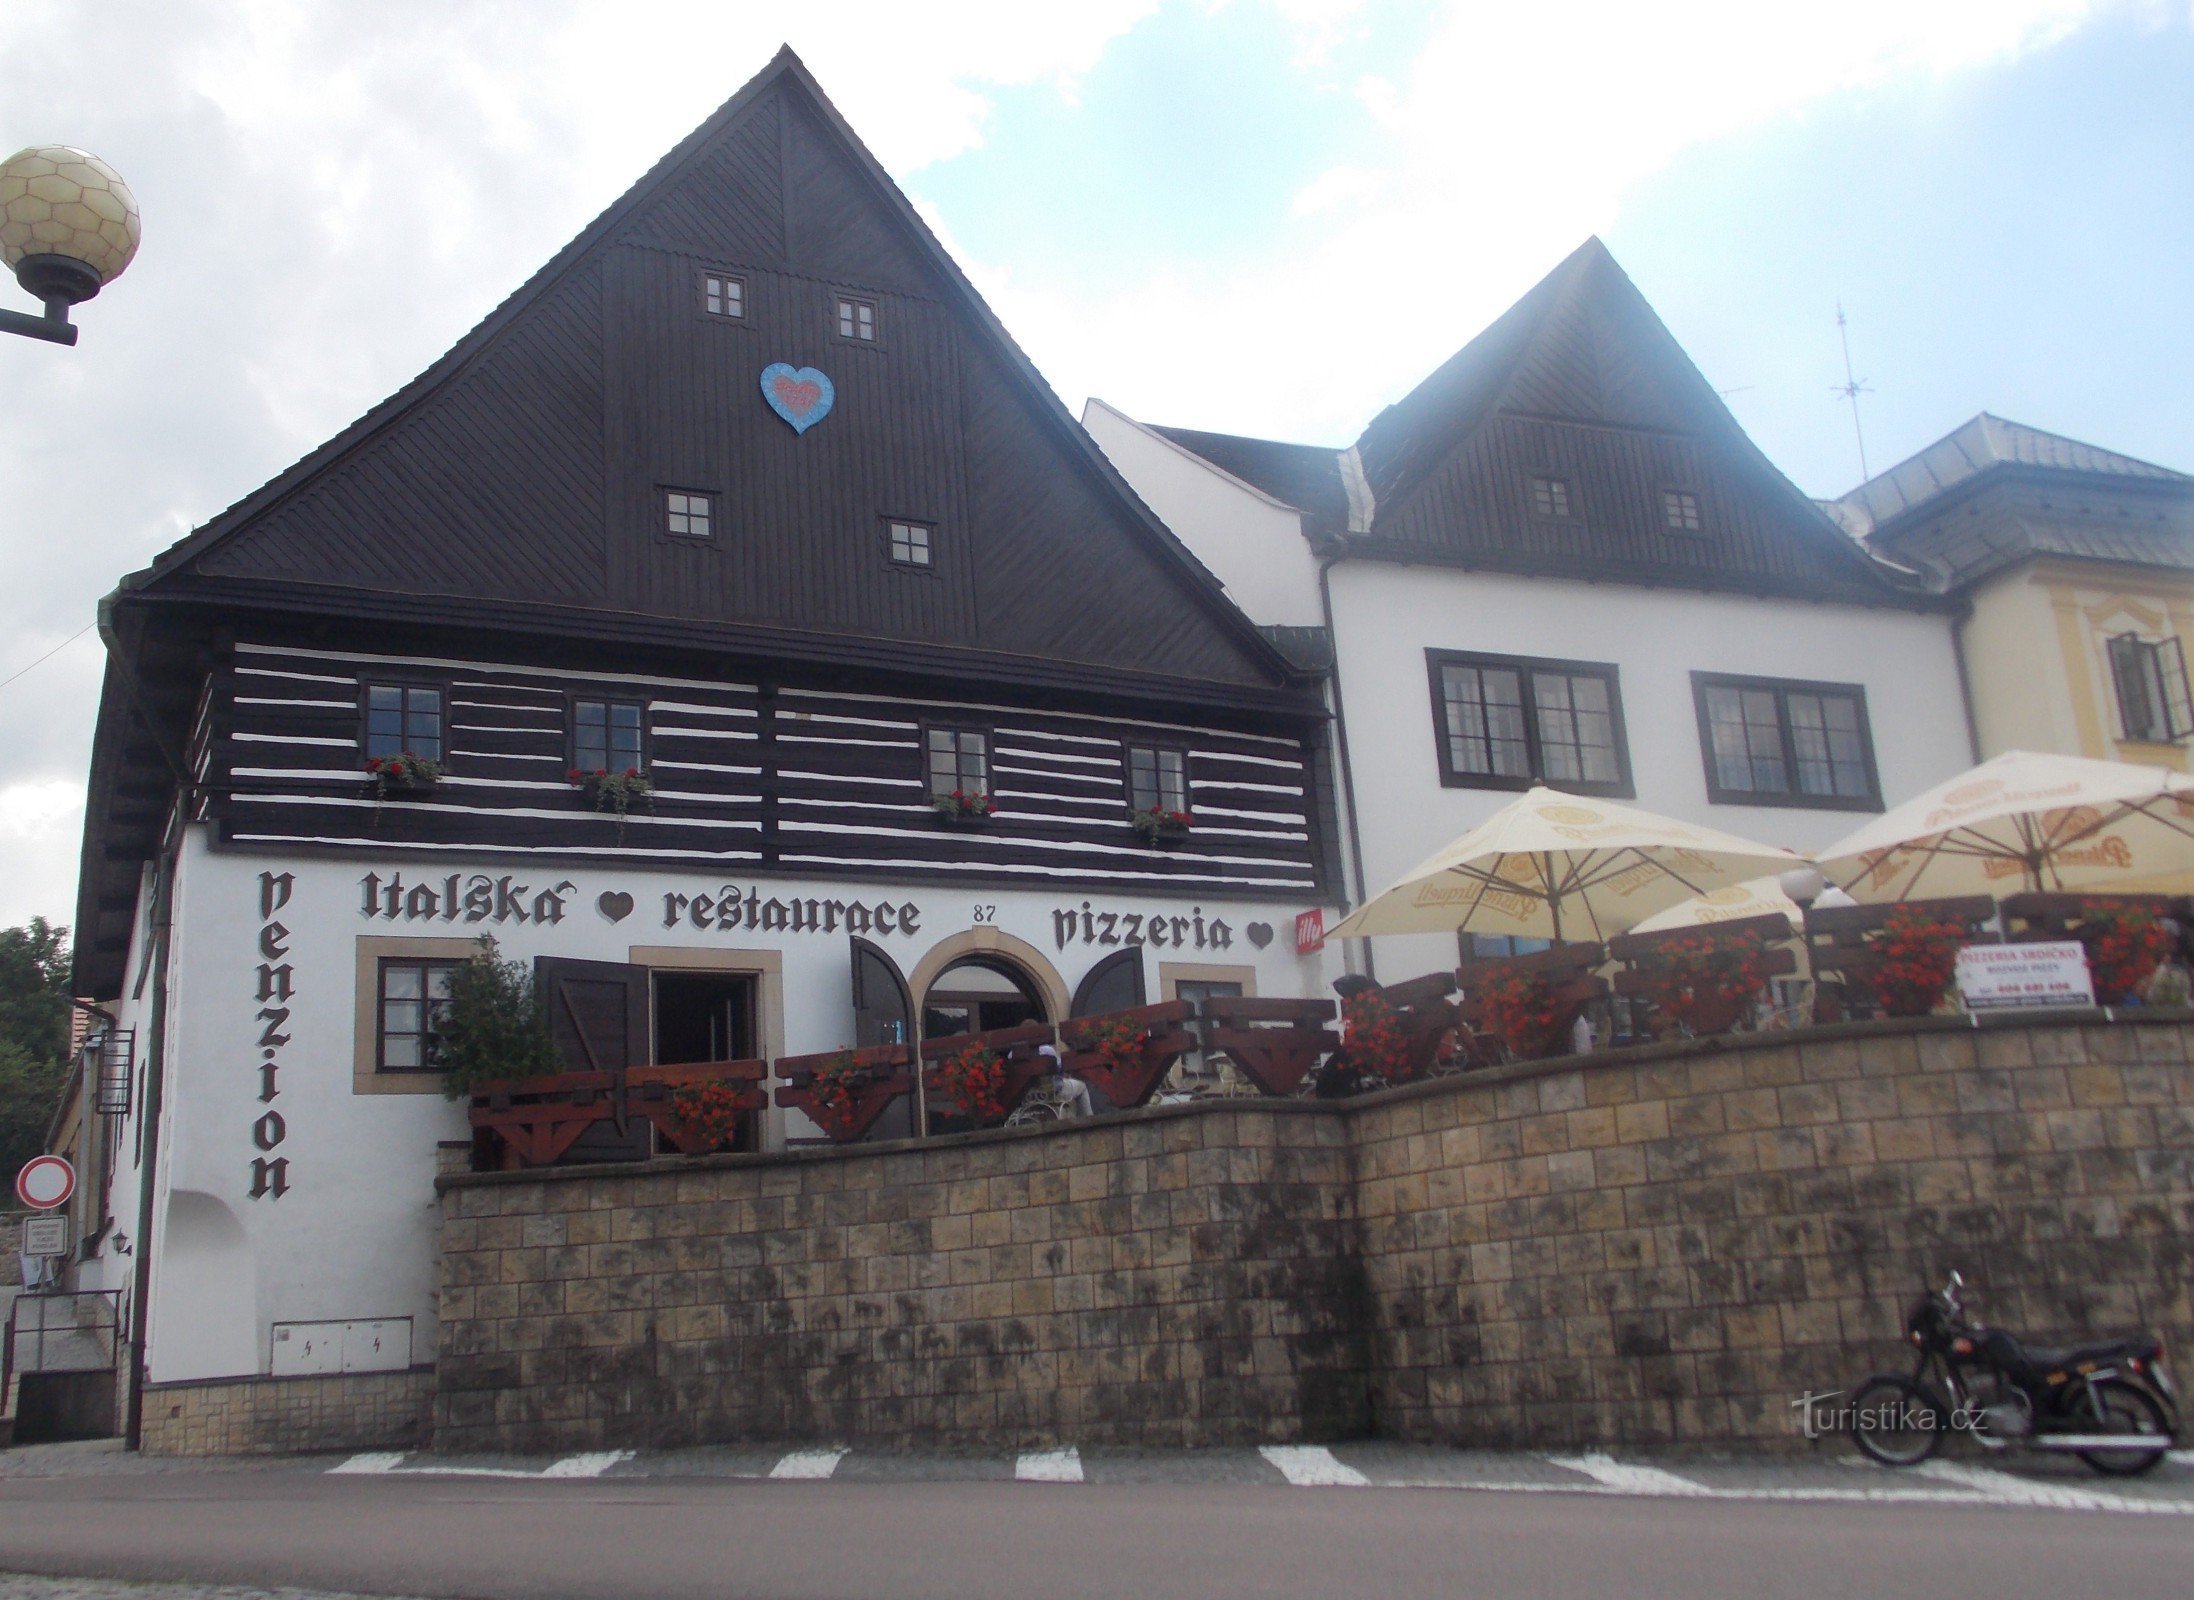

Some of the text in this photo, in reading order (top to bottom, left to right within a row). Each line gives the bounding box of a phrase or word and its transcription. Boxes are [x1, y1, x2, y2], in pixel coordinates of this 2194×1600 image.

[360, 870, 1233, 951] Italská restaurace pizzeria
[973, 904, 996, 923] 87
[1298, 917, 1321, 946] illy
